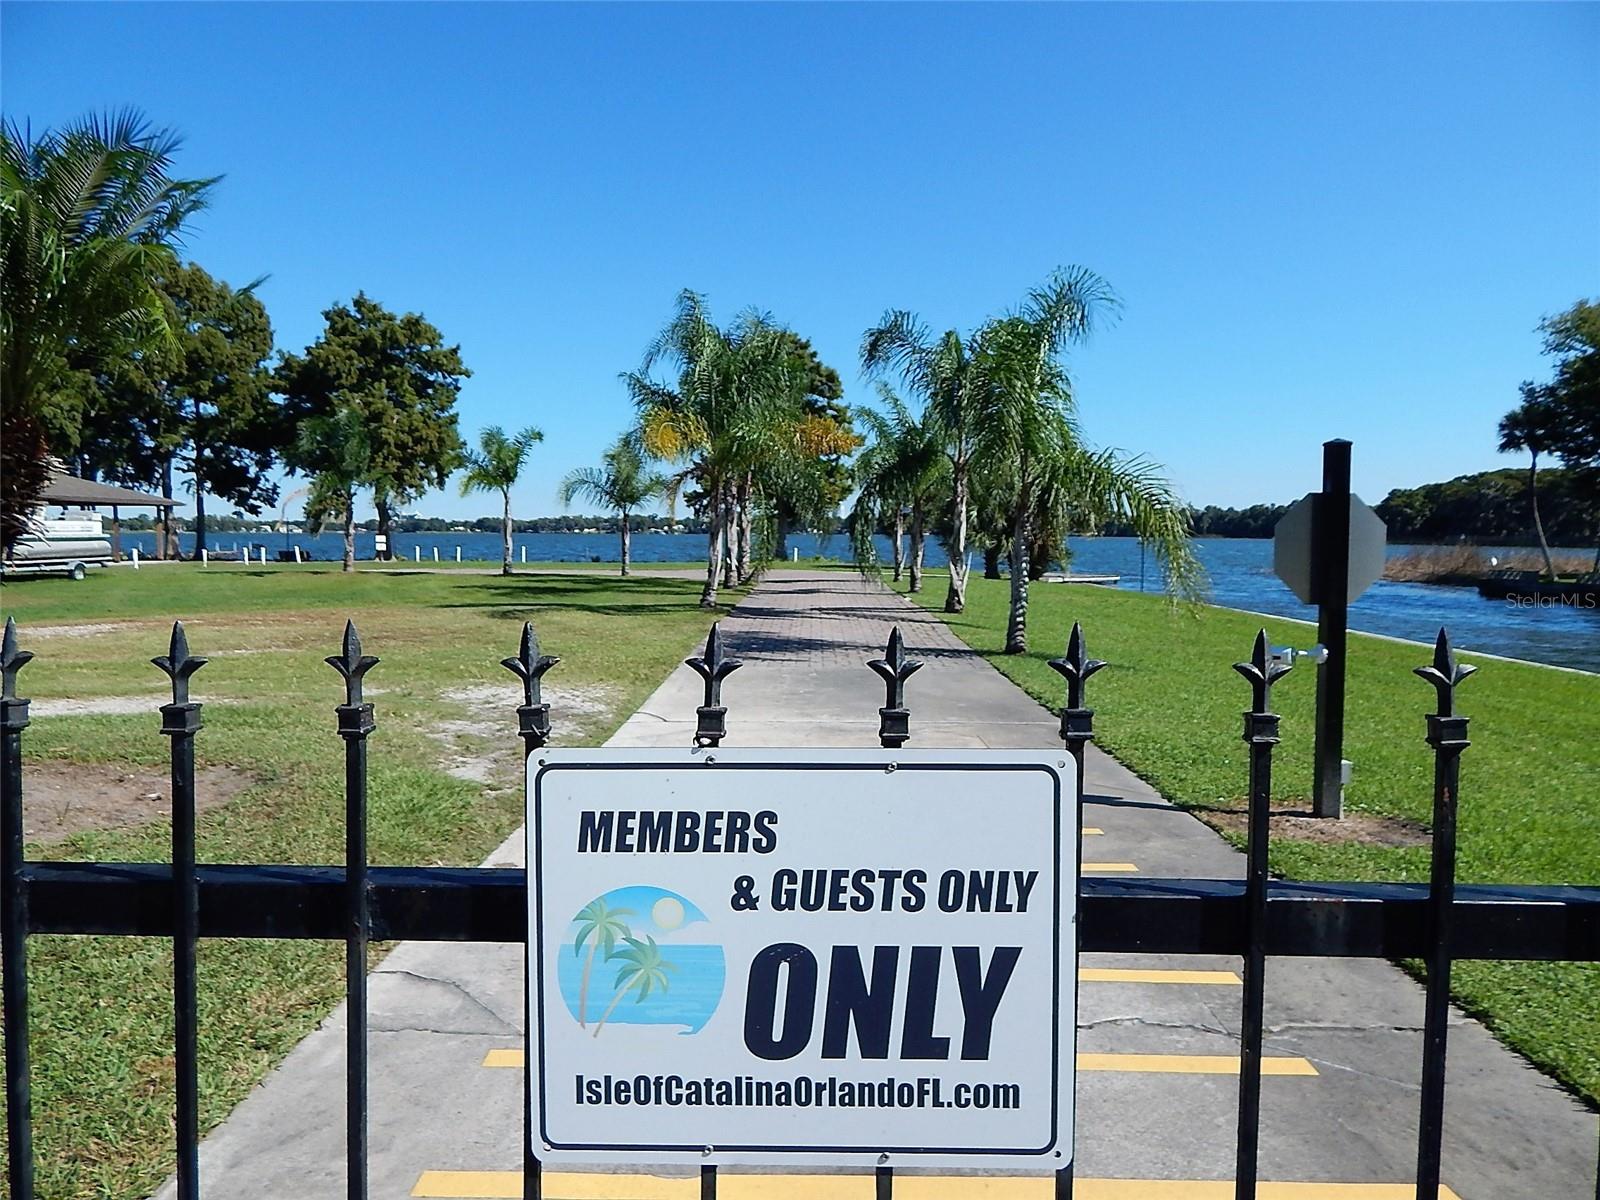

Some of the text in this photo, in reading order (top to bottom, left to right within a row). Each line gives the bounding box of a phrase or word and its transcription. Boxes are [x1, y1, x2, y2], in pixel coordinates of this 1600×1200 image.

[577, 811, 779, 853] MEMBERS
[730, 868, 1039, 913] & GUESTS ONLY
[743, 942, 1023, 1060] ONLY
[575, 1074, 1020, 1109] IsleOfCatalinaOrlandoFL.com
